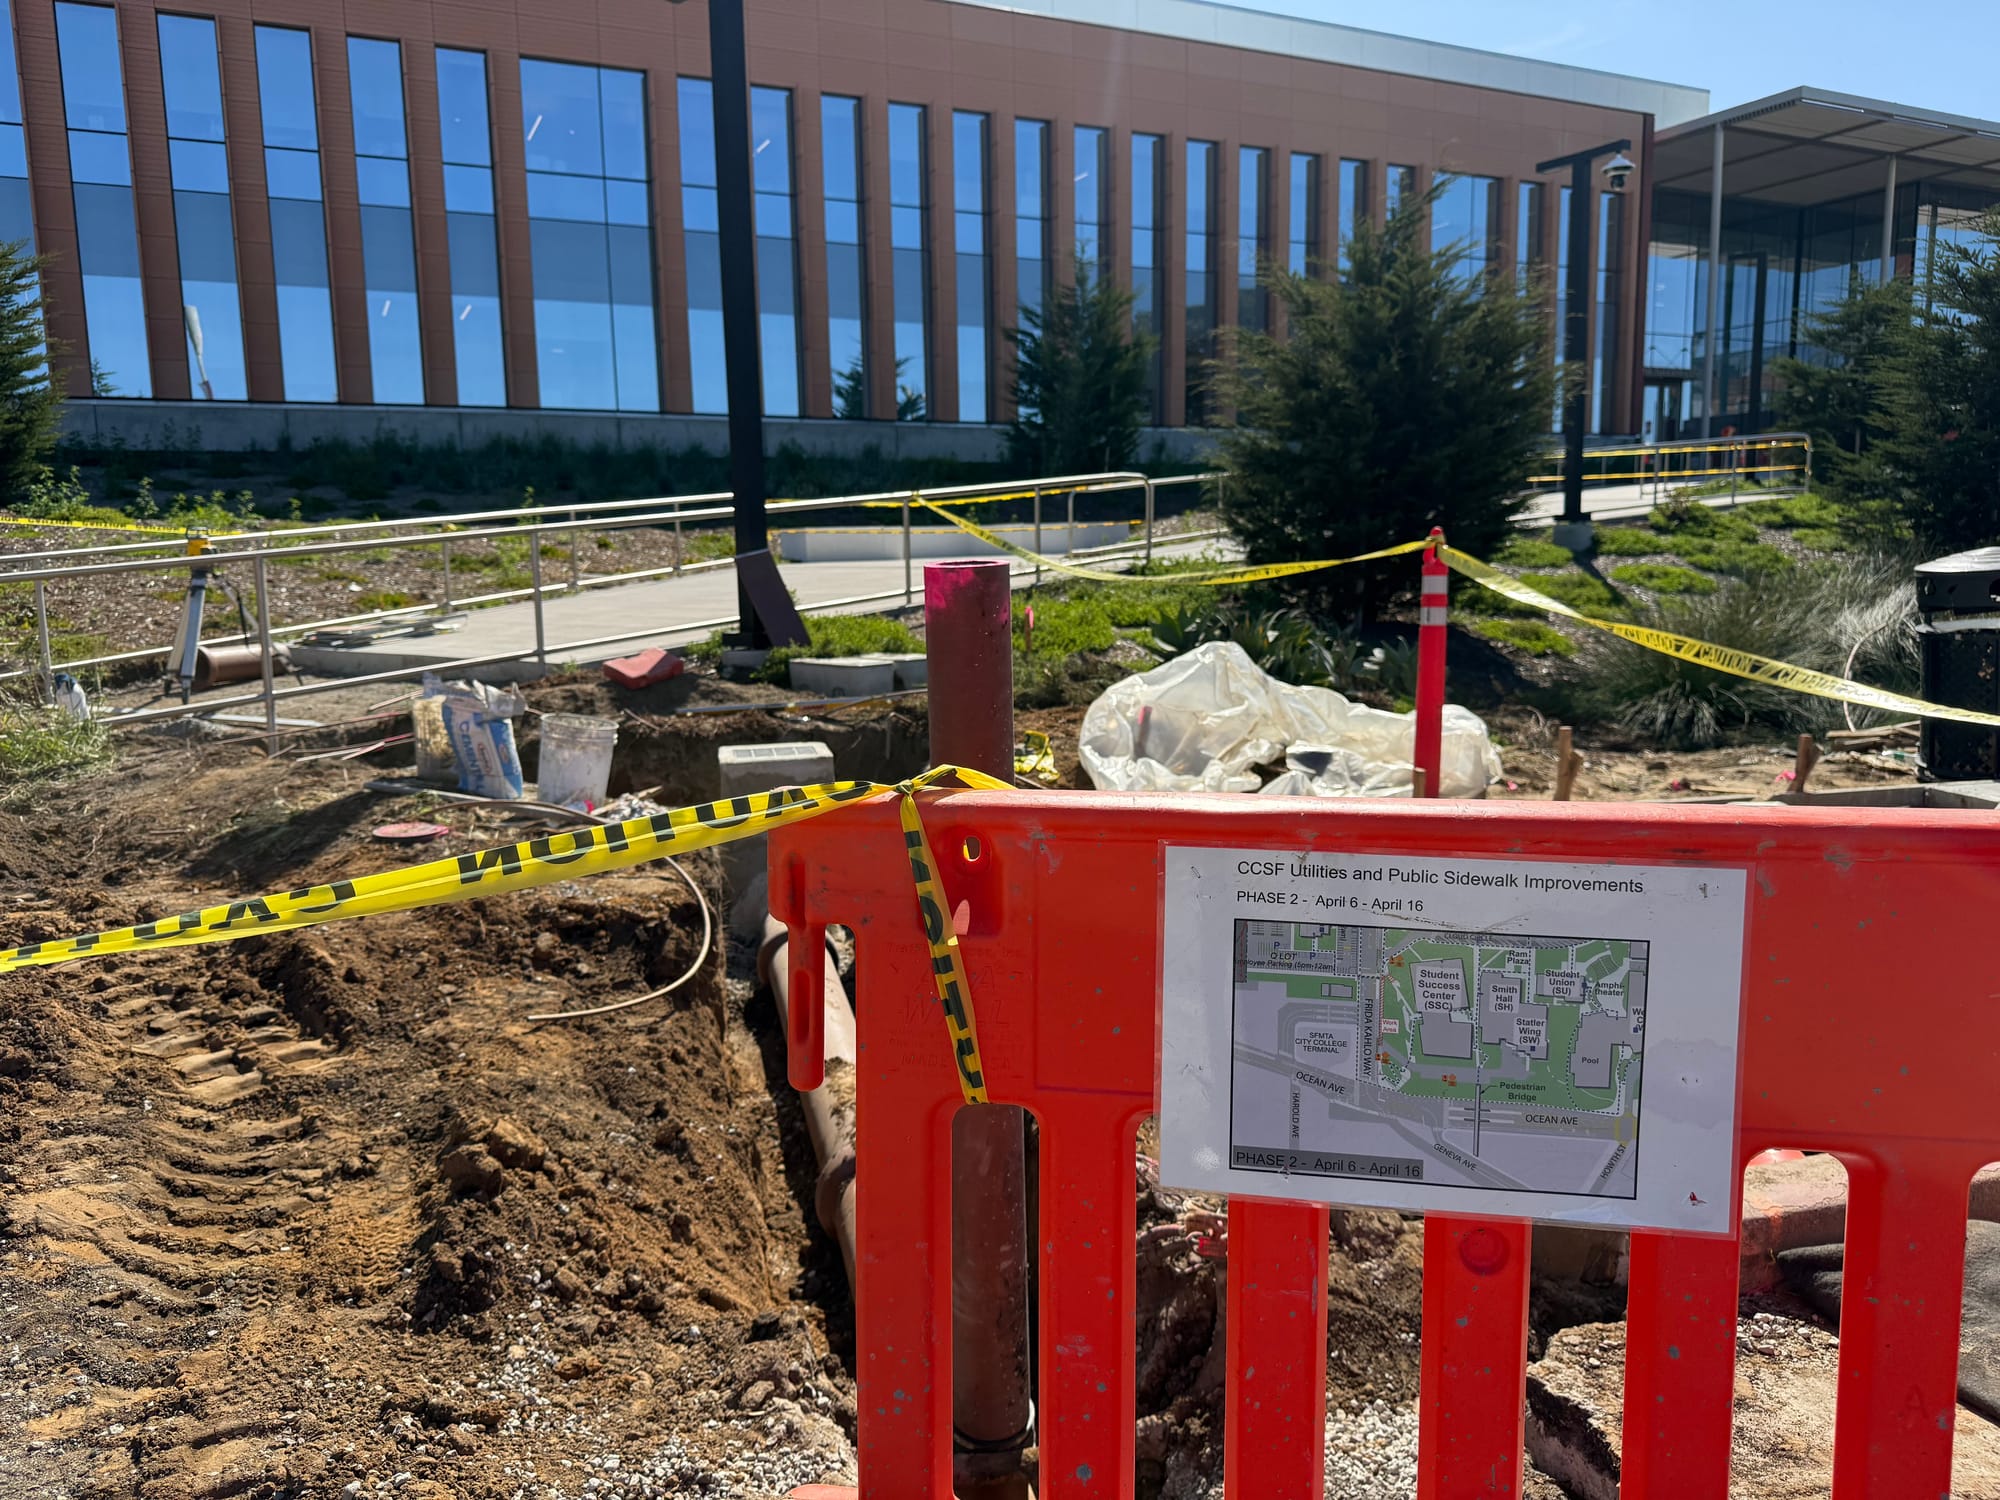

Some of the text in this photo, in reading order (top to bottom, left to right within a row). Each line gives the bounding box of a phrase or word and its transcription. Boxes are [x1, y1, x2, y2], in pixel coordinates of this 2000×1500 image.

[1701, 644, 1753, 673] CAUTION
[1237, 861, 1644, 893] CCSF Utilities and Public Sidewalk Improvements
[1236, 891, 1286, 904] PHASE
[1289, 893, 1298, 905] 2
[1315, 894, 1345, 909] April
[1349, 896, 1358, 908] 6
[1371, 898, 1402, 912] April
[1408, 900, 1424, 912] 16
[1279, 952, 1297, 960] LOT
[1508, 949, 1529, 958] Ram
[1267, 960, 1293, 969] Parking
[1506, 957, 1529, 966] Plaza
[1420, 969, 1459, 980] Student
[1545, 969, 1580, 979] Student
[1418, 979, 1461, 990] Success
[1549, 978, 1576, 987] Union
[1491, 984, 1518, 994] Smith
[1552, 986, 1571, 996] (SU)
[1594, 988, 1625, 997] theater
[1422, 990, 1456, 1000] Center
[1495, 994, 1513, 1003] Hall
[1424, 1000, 1453, 1012] (SSC)
[1494, 1002, 1514, 1013] (SH)
[1516, 1017, 1545, 1027] Statler
[1309, 1032, 1334, 1040] SFMTA
[1363, 998, 1373, 1076] FRIDA KAHLO WAY
[1519, 1026, 1541, 1037] Wing
[1295, 1038, 1347, 1048] CITY COLLEGE
[1519, 1035, 1540, 1046] (SW)
[1303, 1045, 1339, 1054] TERMINAL
[1581, 1056, 1599, 1065] Pool
[1296, 1071, 1345, 1095] OCEAN AVE
[1499, 1081, 1546, 1092] Pedestrian
[1507, 1091, 1537, 1102] Bridge
[1291, 1092, 1300, 1139] HAROLD AVE
[1525, 1114, 1579, 1126] OCEAN AVE
[1433, 1142, 1477, 1172] GENEVA AVE
[1600, 1143, 1627, 1180] HOWTH ST
[1236, 1151, 1285, 1167] PHASE
[1289, 1156, 1297, 1168] 2
[1314, 1157, 1344, 1173] April
[1347, 1160, 1356, 1172] 6
[1369, 1162, 1399, 1177] April
[1405, 1164, 1420, 1177] 16
